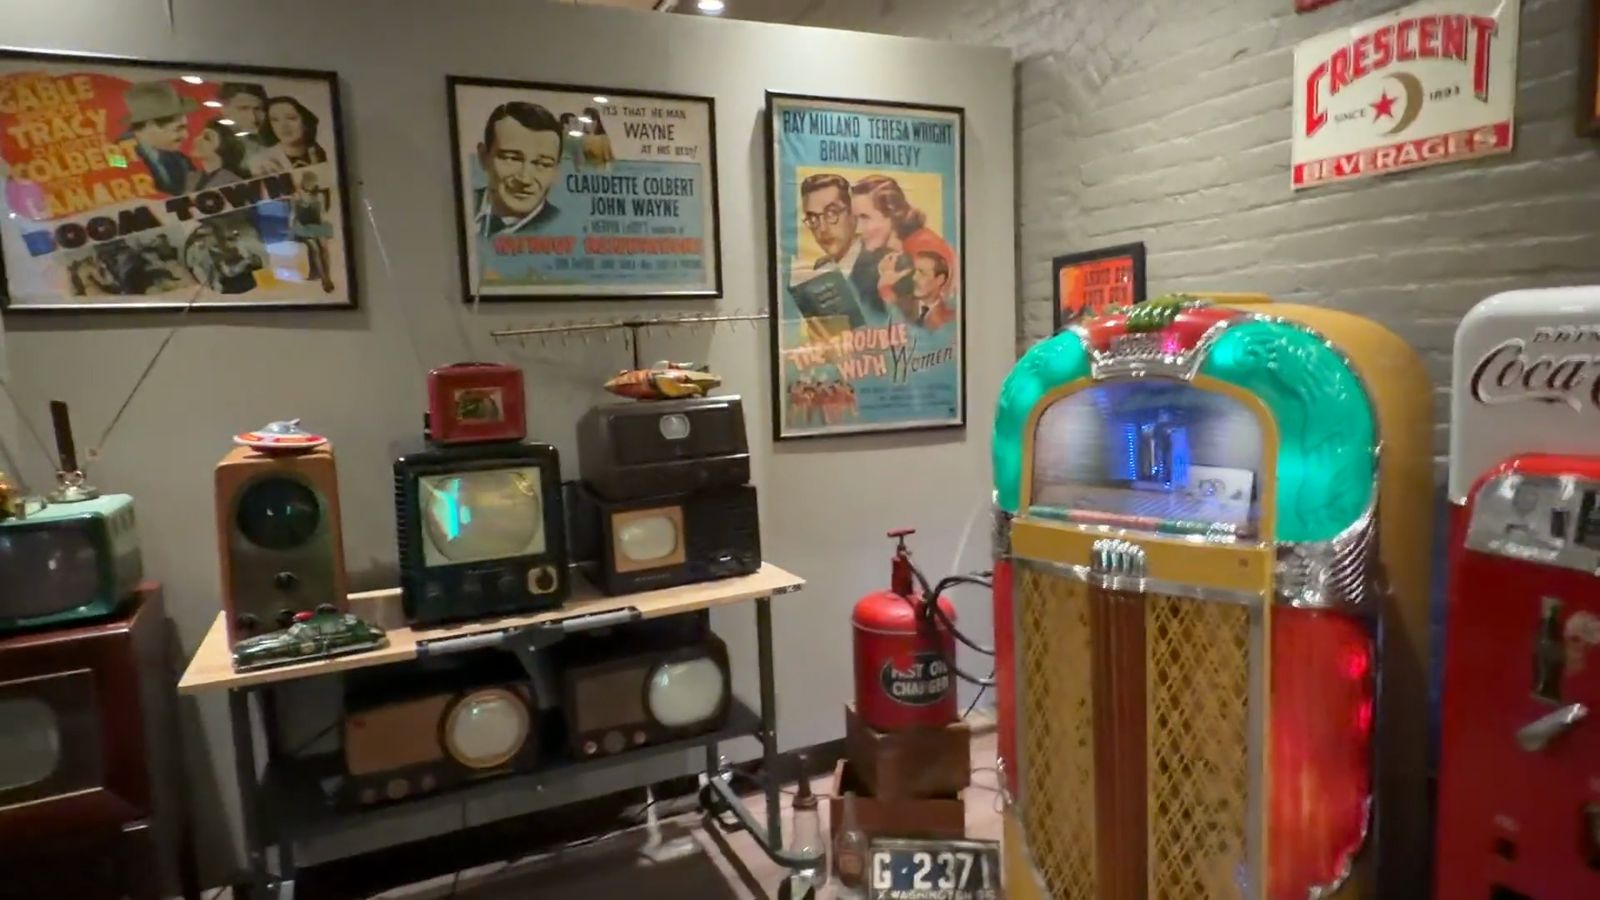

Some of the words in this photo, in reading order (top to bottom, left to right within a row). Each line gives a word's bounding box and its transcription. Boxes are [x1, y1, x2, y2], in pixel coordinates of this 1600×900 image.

[1305, 14, 1499, 139] CRESCENT
[7, 108, 108, 150] TRACY
[623, 121, 675, 141] WAYNE
[783, 110, 806, 134] RAY
[809, 112, 861, 138] MILLAND
[867, 118, 910, 142] TERESA
[913, 120, 953, 146] WRIGHT
[1334, 108, 1367, 123] SINCE
[11, 139, 139, 182] COLBERT
[820, 139, 860, 163] BRIAN
[864, 142, 921, 167] DONLEVY
[1302, 126, 1498, 182] BEVERAGES
[165, 172, 297, 222] TOWN
[566, 174, 639, 196] CLAUDETTE
[643, 177, 694, 197] COLBERT
[590, 197, 626, 216] JOHN
[632, 199, 680, 218] WAYNE
[830, 323, 908, 357] TROUBLE
[837, 354, 888, 381] WITH
[887, 328, 953, 384] Women
[873, 852, 891, 889] G
[912, 852, 991, 890] 2371
